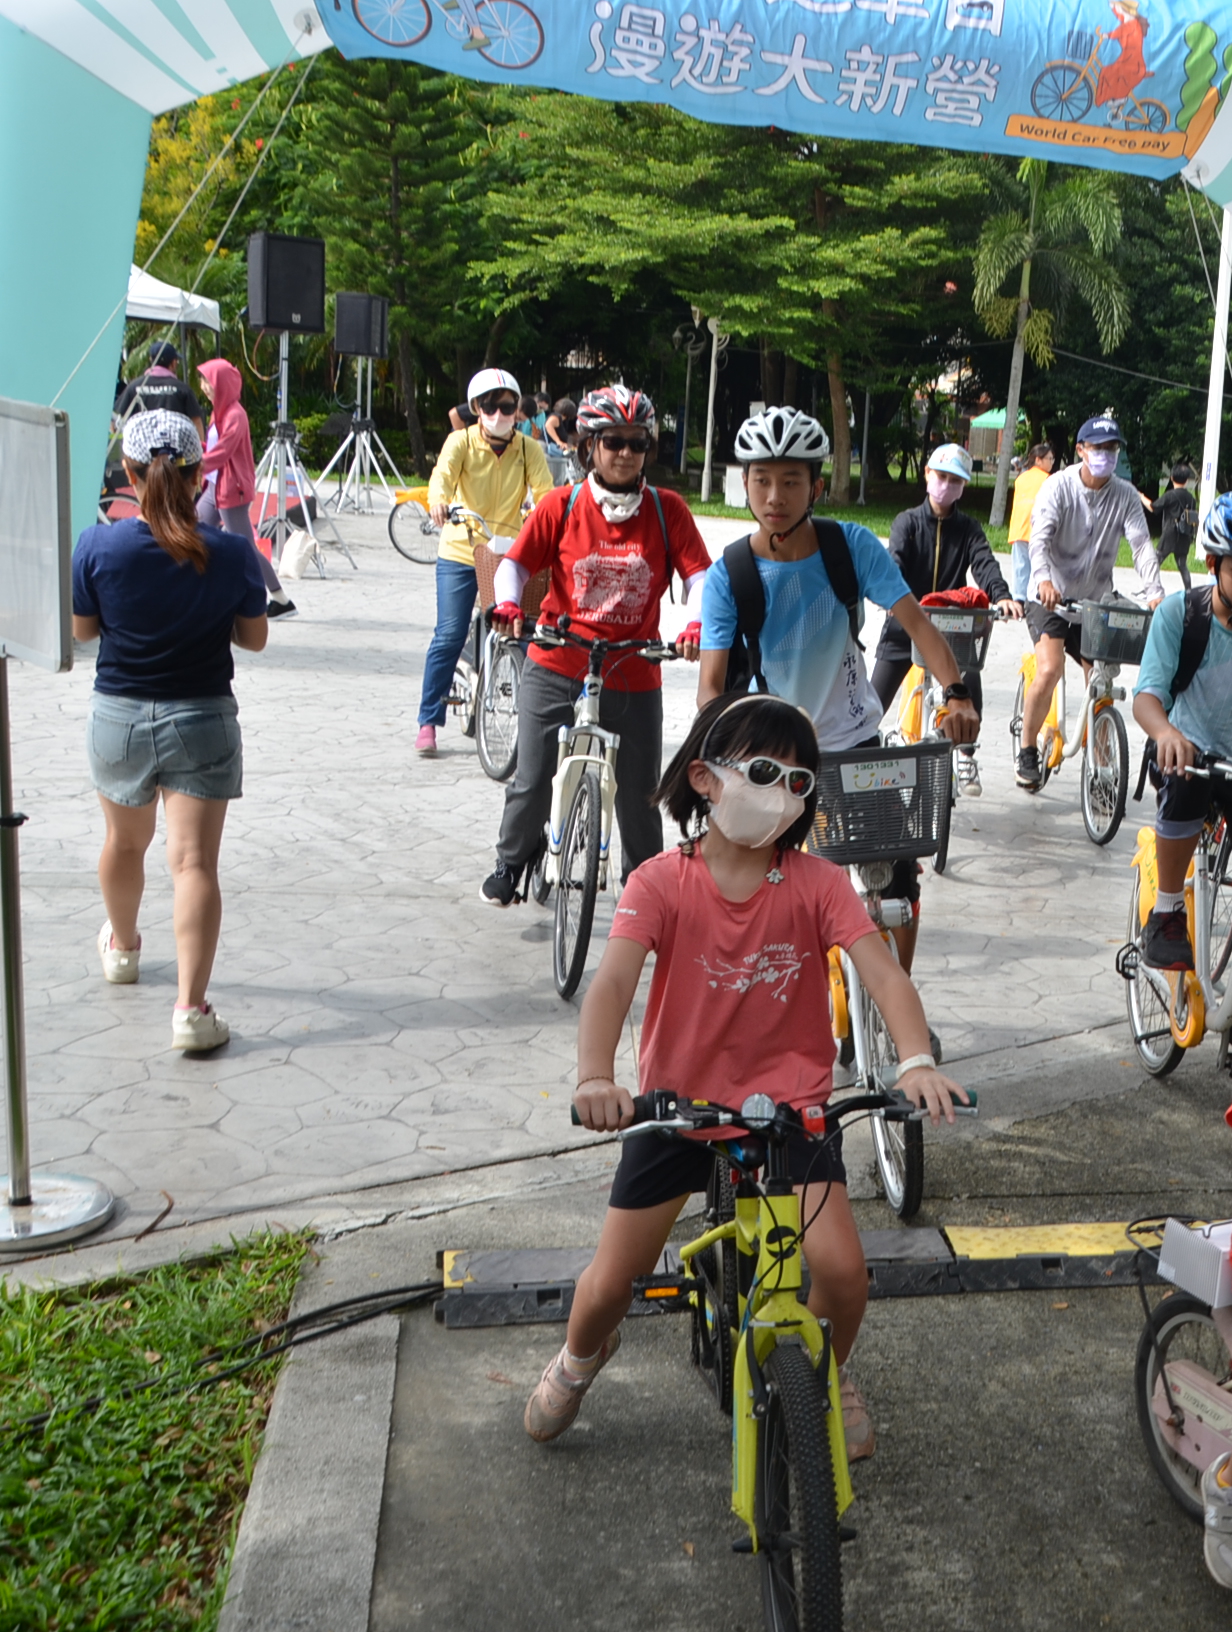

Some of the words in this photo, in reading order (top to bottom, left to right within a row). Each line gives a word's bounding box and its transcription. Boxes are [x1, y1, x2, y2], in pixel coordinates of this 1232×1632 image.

[586, 2, 1000, 127] 漫遊大新營
[1019, 122, 1067, 141] World
[1071, 132, 1099, 144] Car
[1103, 136, 1136, 149] Free
[599, 540, 612, 550] The
[614, 542, 626, 551] old
[627, 541, 642, 552] city
